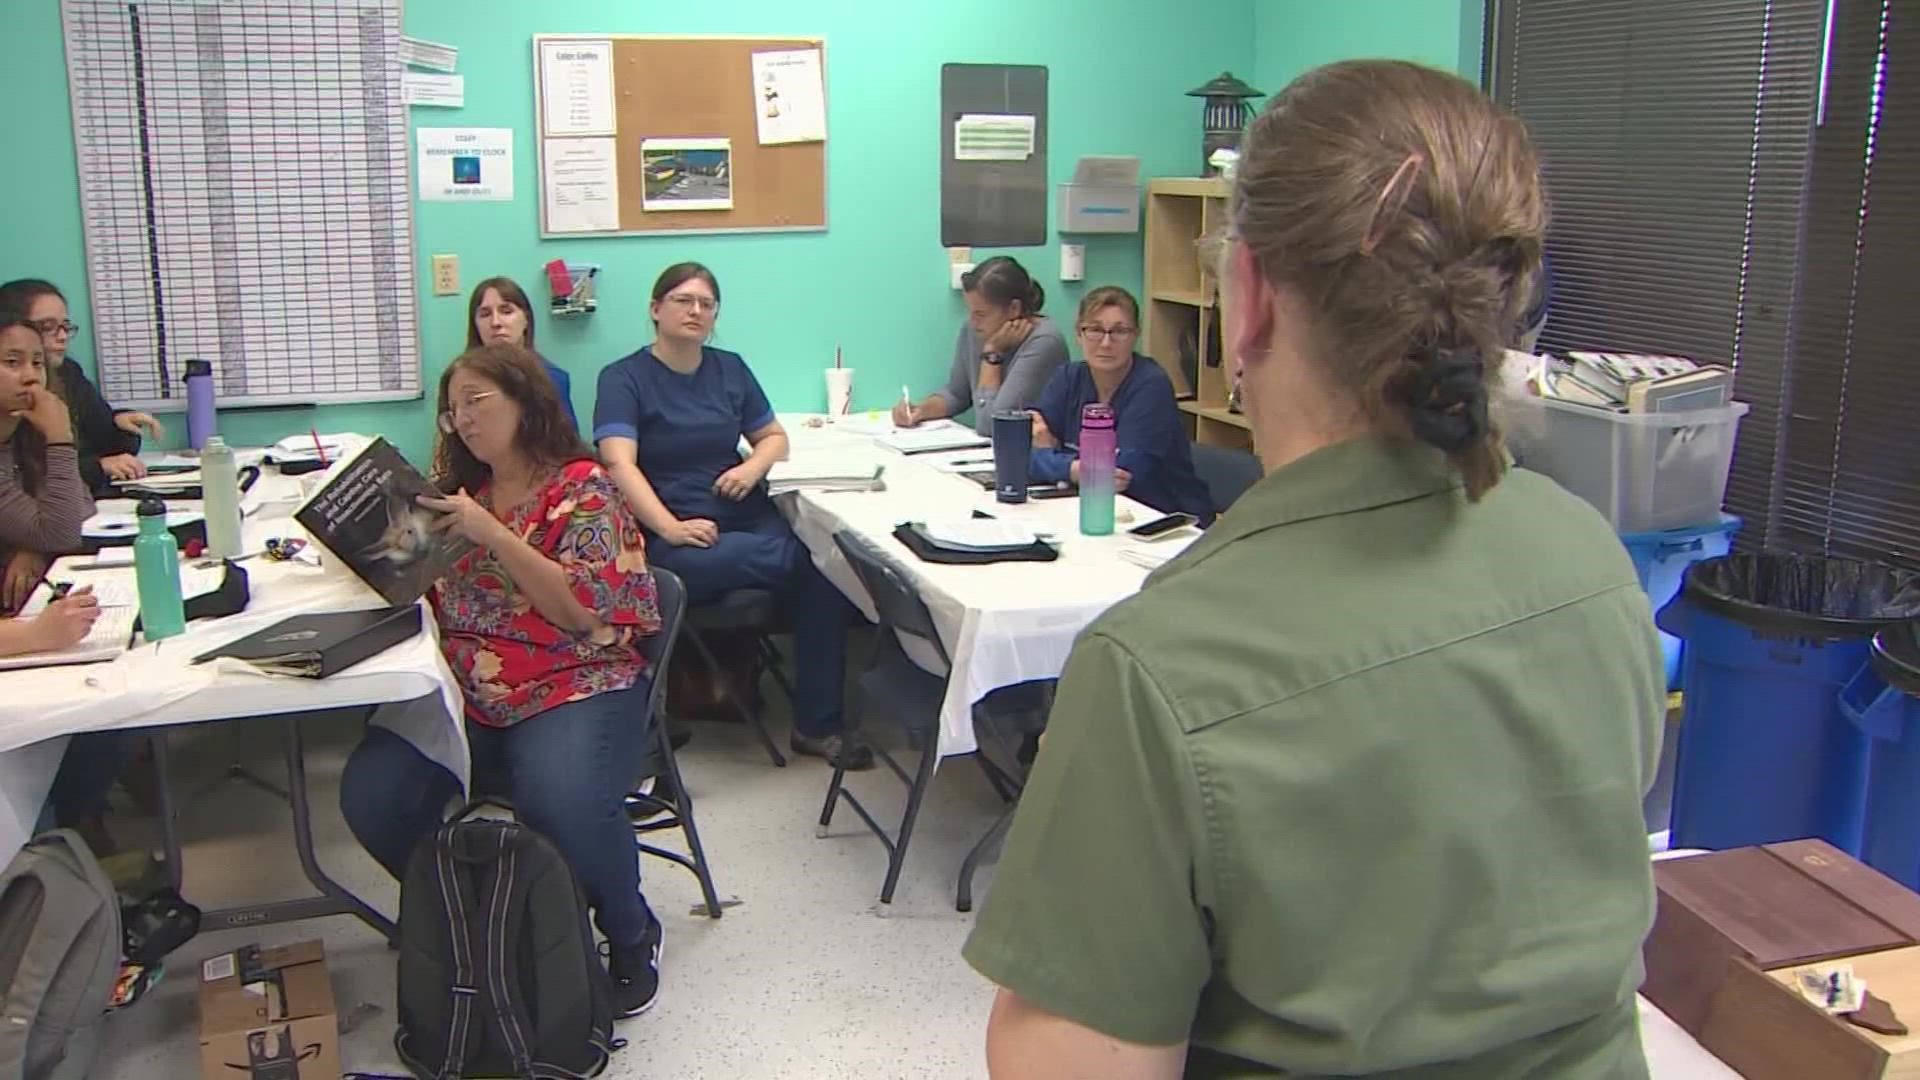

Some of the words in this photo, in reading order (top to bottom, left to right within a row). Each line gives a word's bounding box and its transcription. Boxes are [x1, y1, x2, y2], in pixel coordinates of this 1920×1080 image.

[483, 148, 506, 156] CLOCK
[313, 499, 328, 512] The
[326, 458, 372, 501] Rehabilitation
[325, 503, 339, 518] and
[337, 482, 363, 506] Captive
[361, 467, 378, 484] Care
[375, 469, 392, 484] Bats
